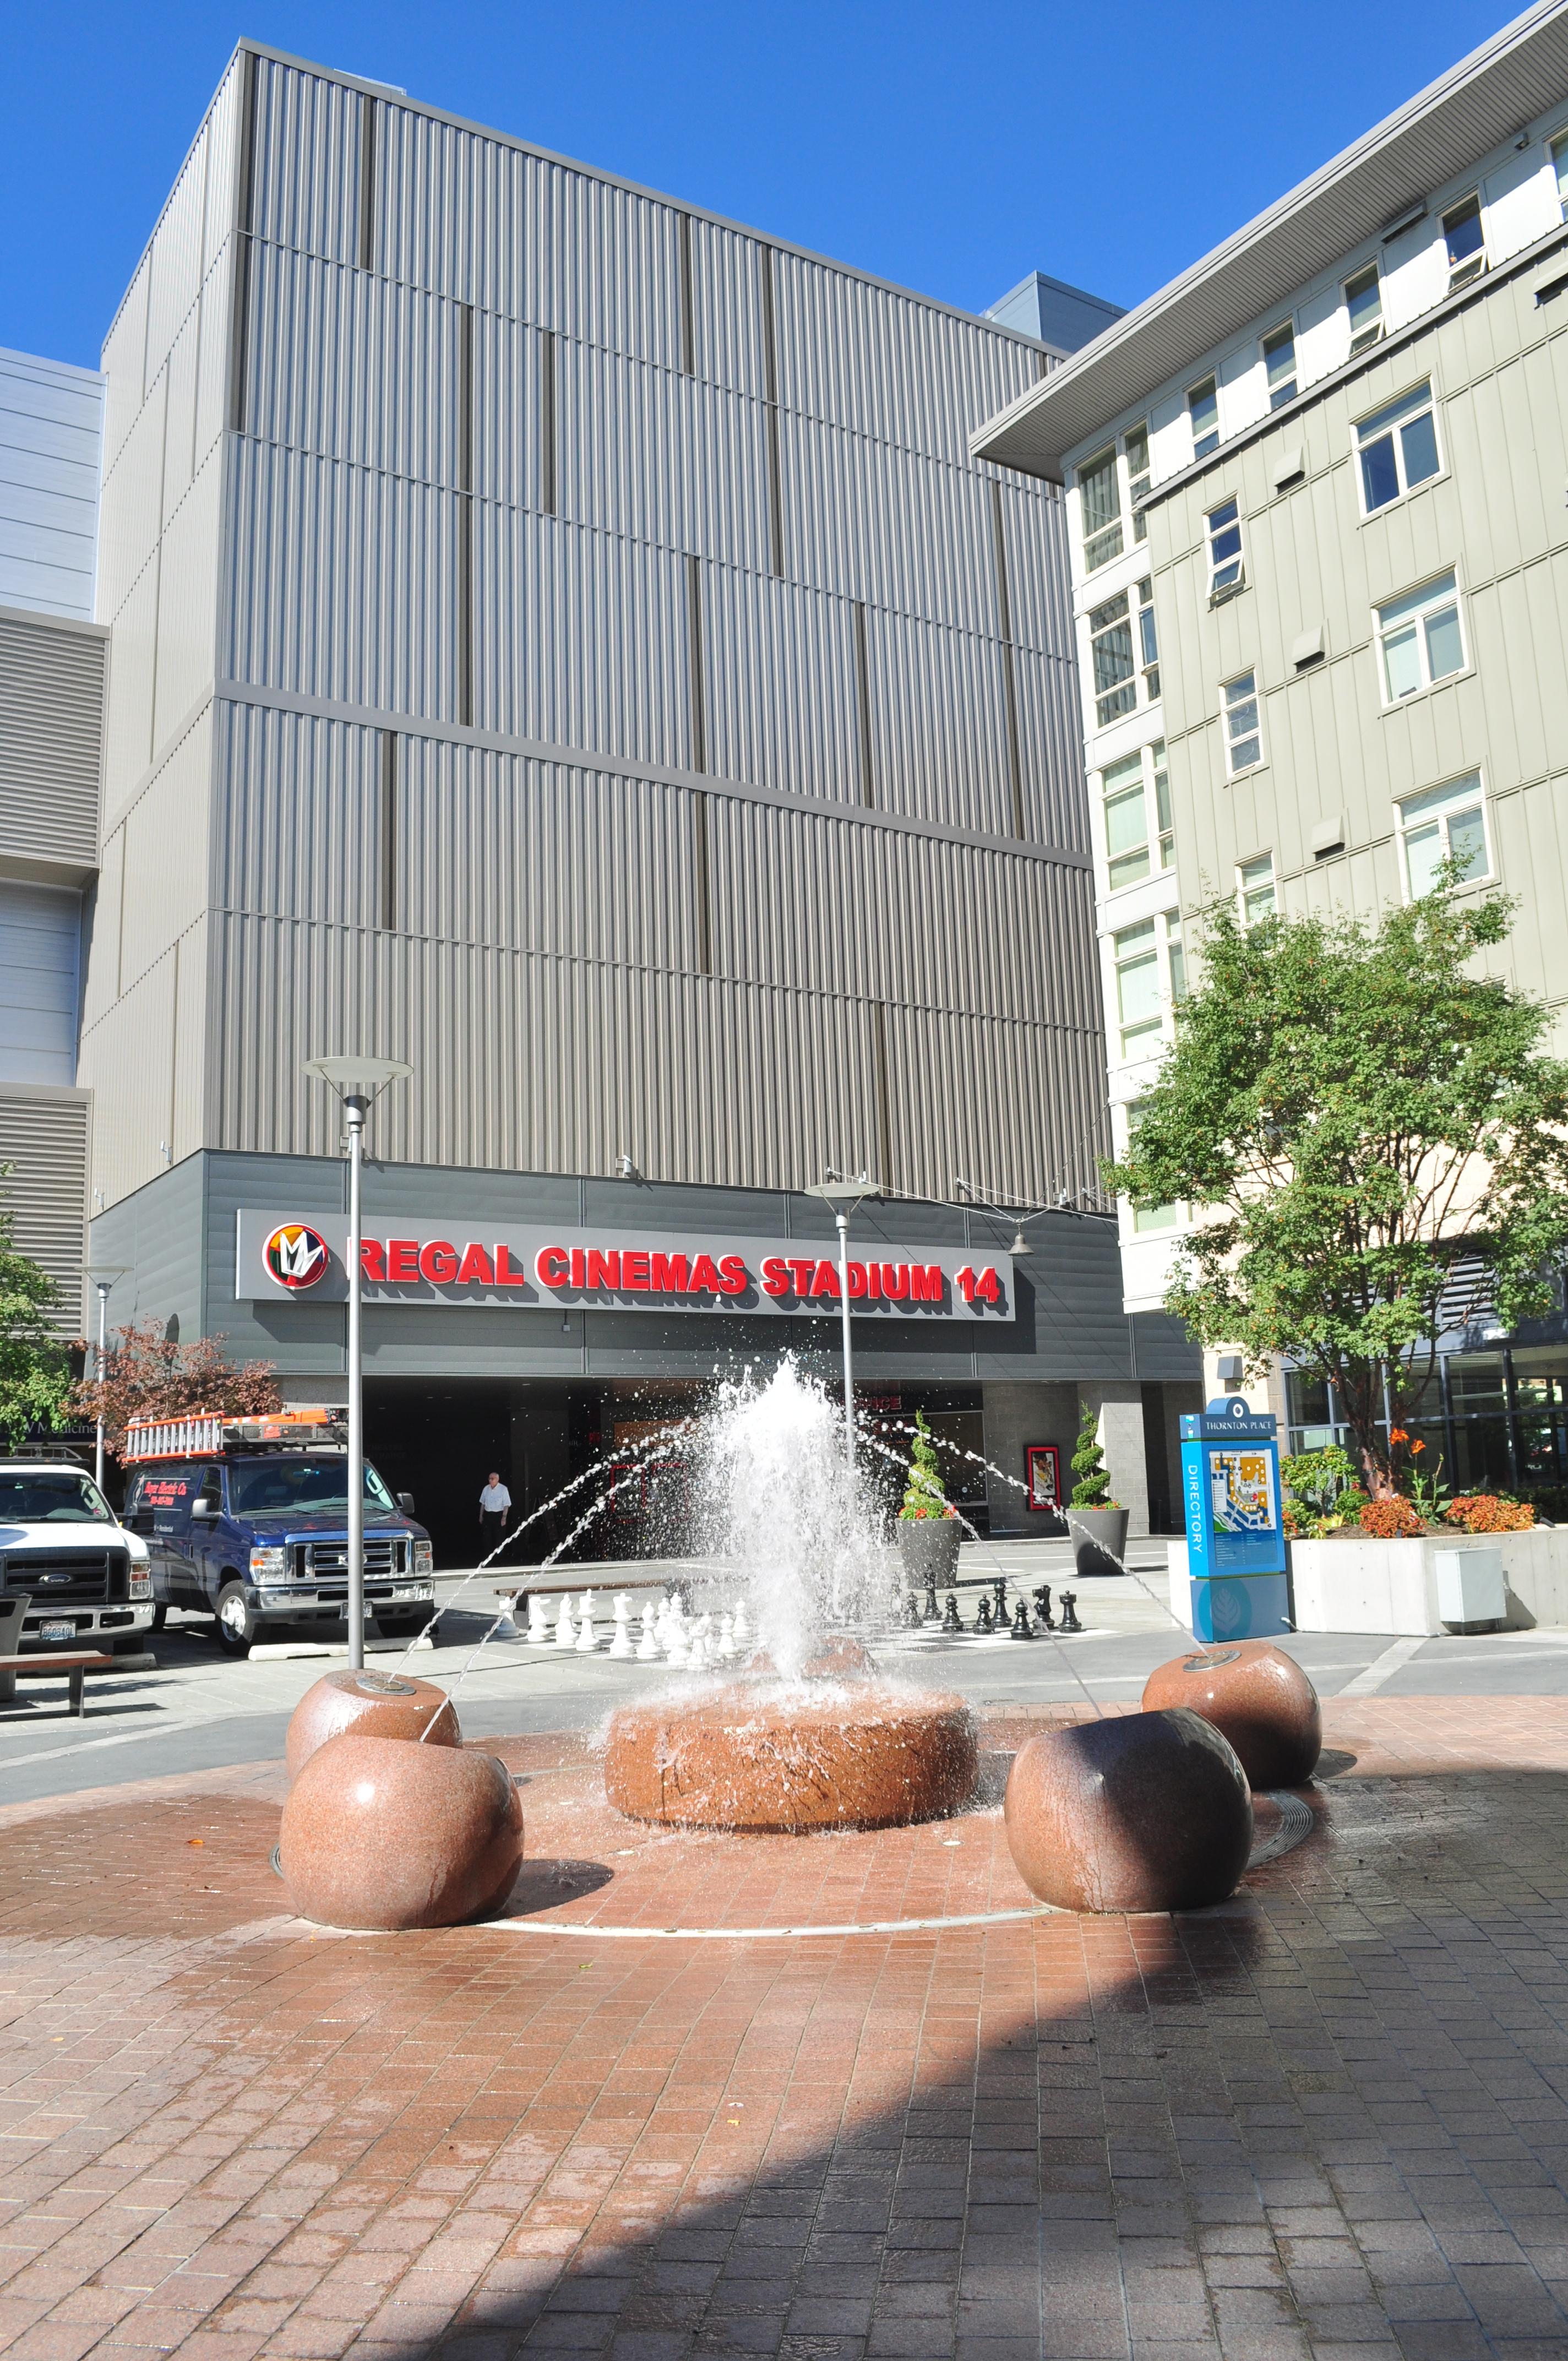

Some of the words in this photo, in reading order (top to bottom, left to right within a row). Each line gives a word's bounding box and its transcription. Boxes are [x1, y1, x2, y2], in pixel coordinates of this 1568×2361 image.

[346, 1236, 524, 1286] REGAL
[535, 1245, 747, 1294] CINEMAS
[760, 1256, 943, 1302] STADIUM
[954, 1265, 1000, 1303] 14
[1206, 1421, 1248, 1430] THORNTON
[1250, 1421, 1272, 1429] PLACE
[1188, 1465, 1203, 1553] DIRECTORY
